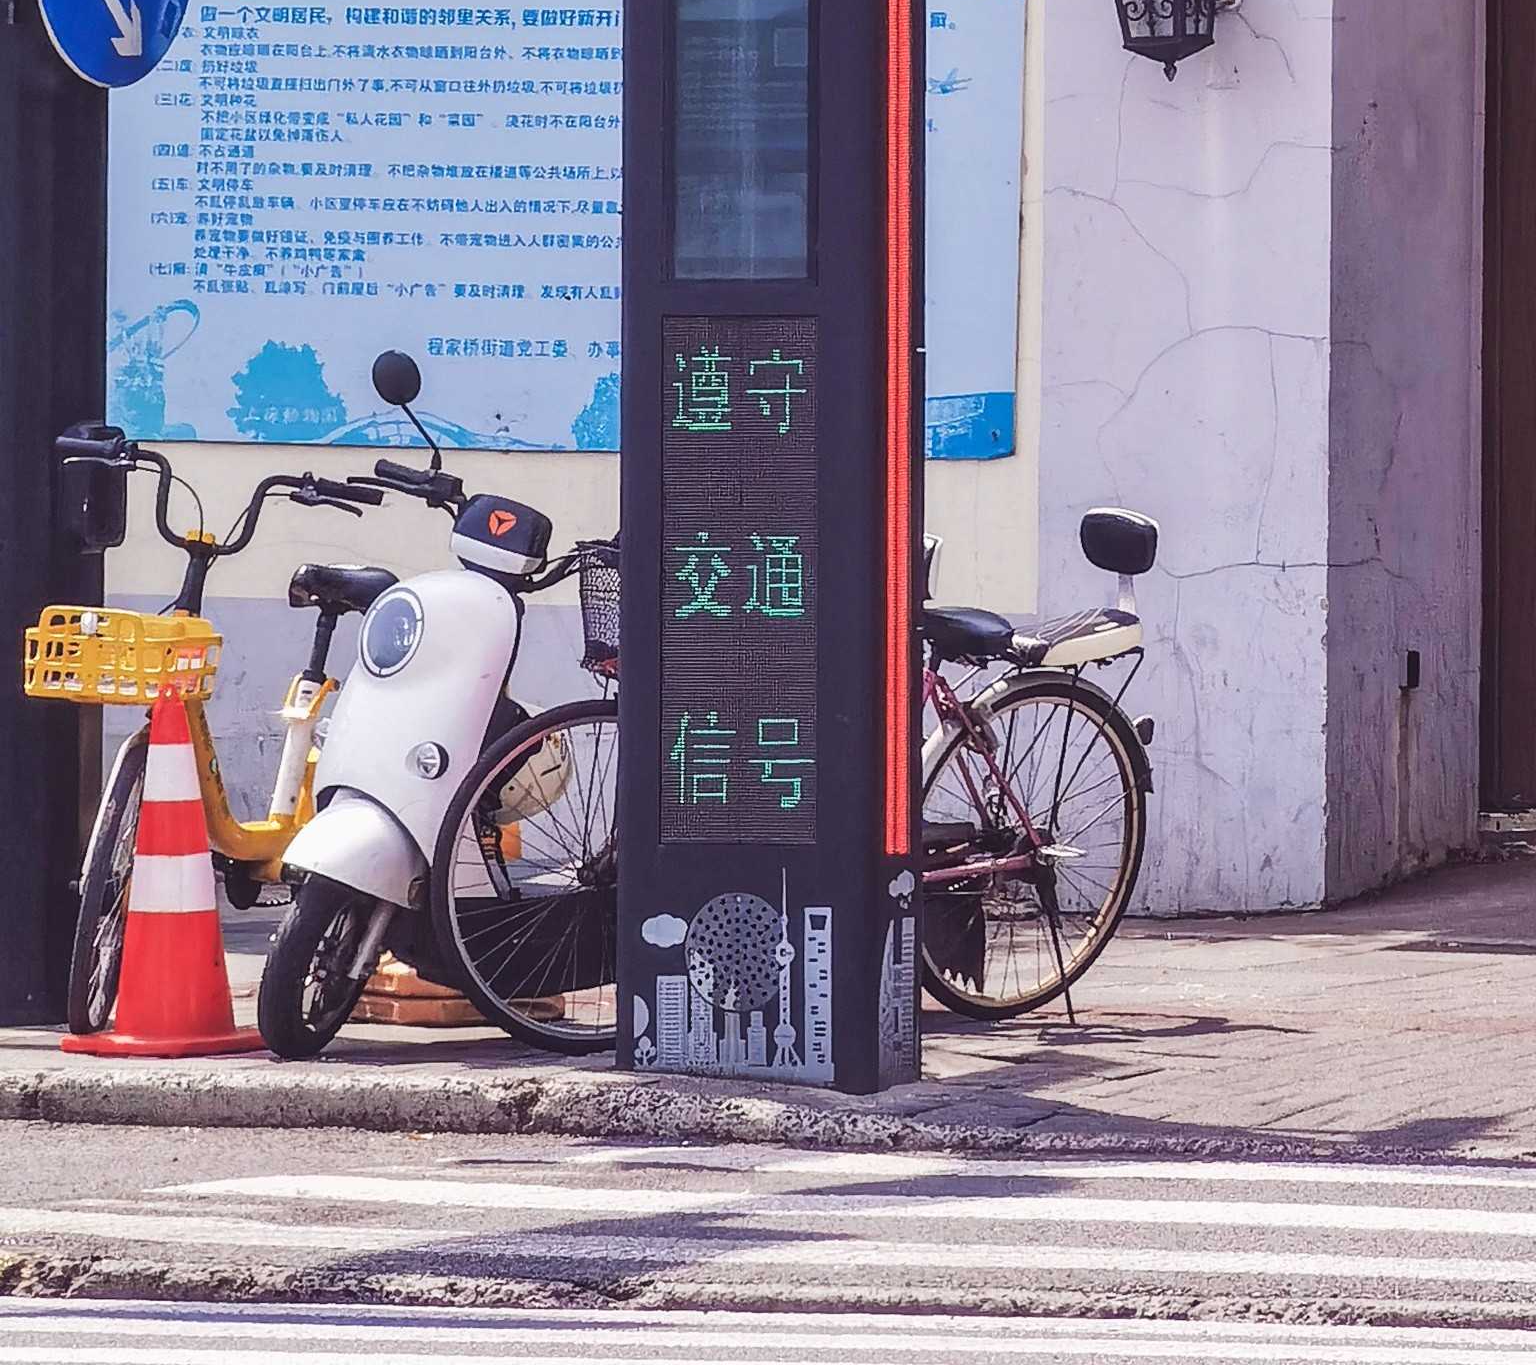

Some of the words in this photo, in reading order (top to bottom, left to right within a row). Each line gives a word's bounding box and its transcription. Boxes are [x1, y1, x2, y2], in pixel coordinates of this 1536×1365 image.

[671, 346, 808, 435] 遵守
[673, 531, 804, 618] 交通
[670, 711, 815, 809] 信号
